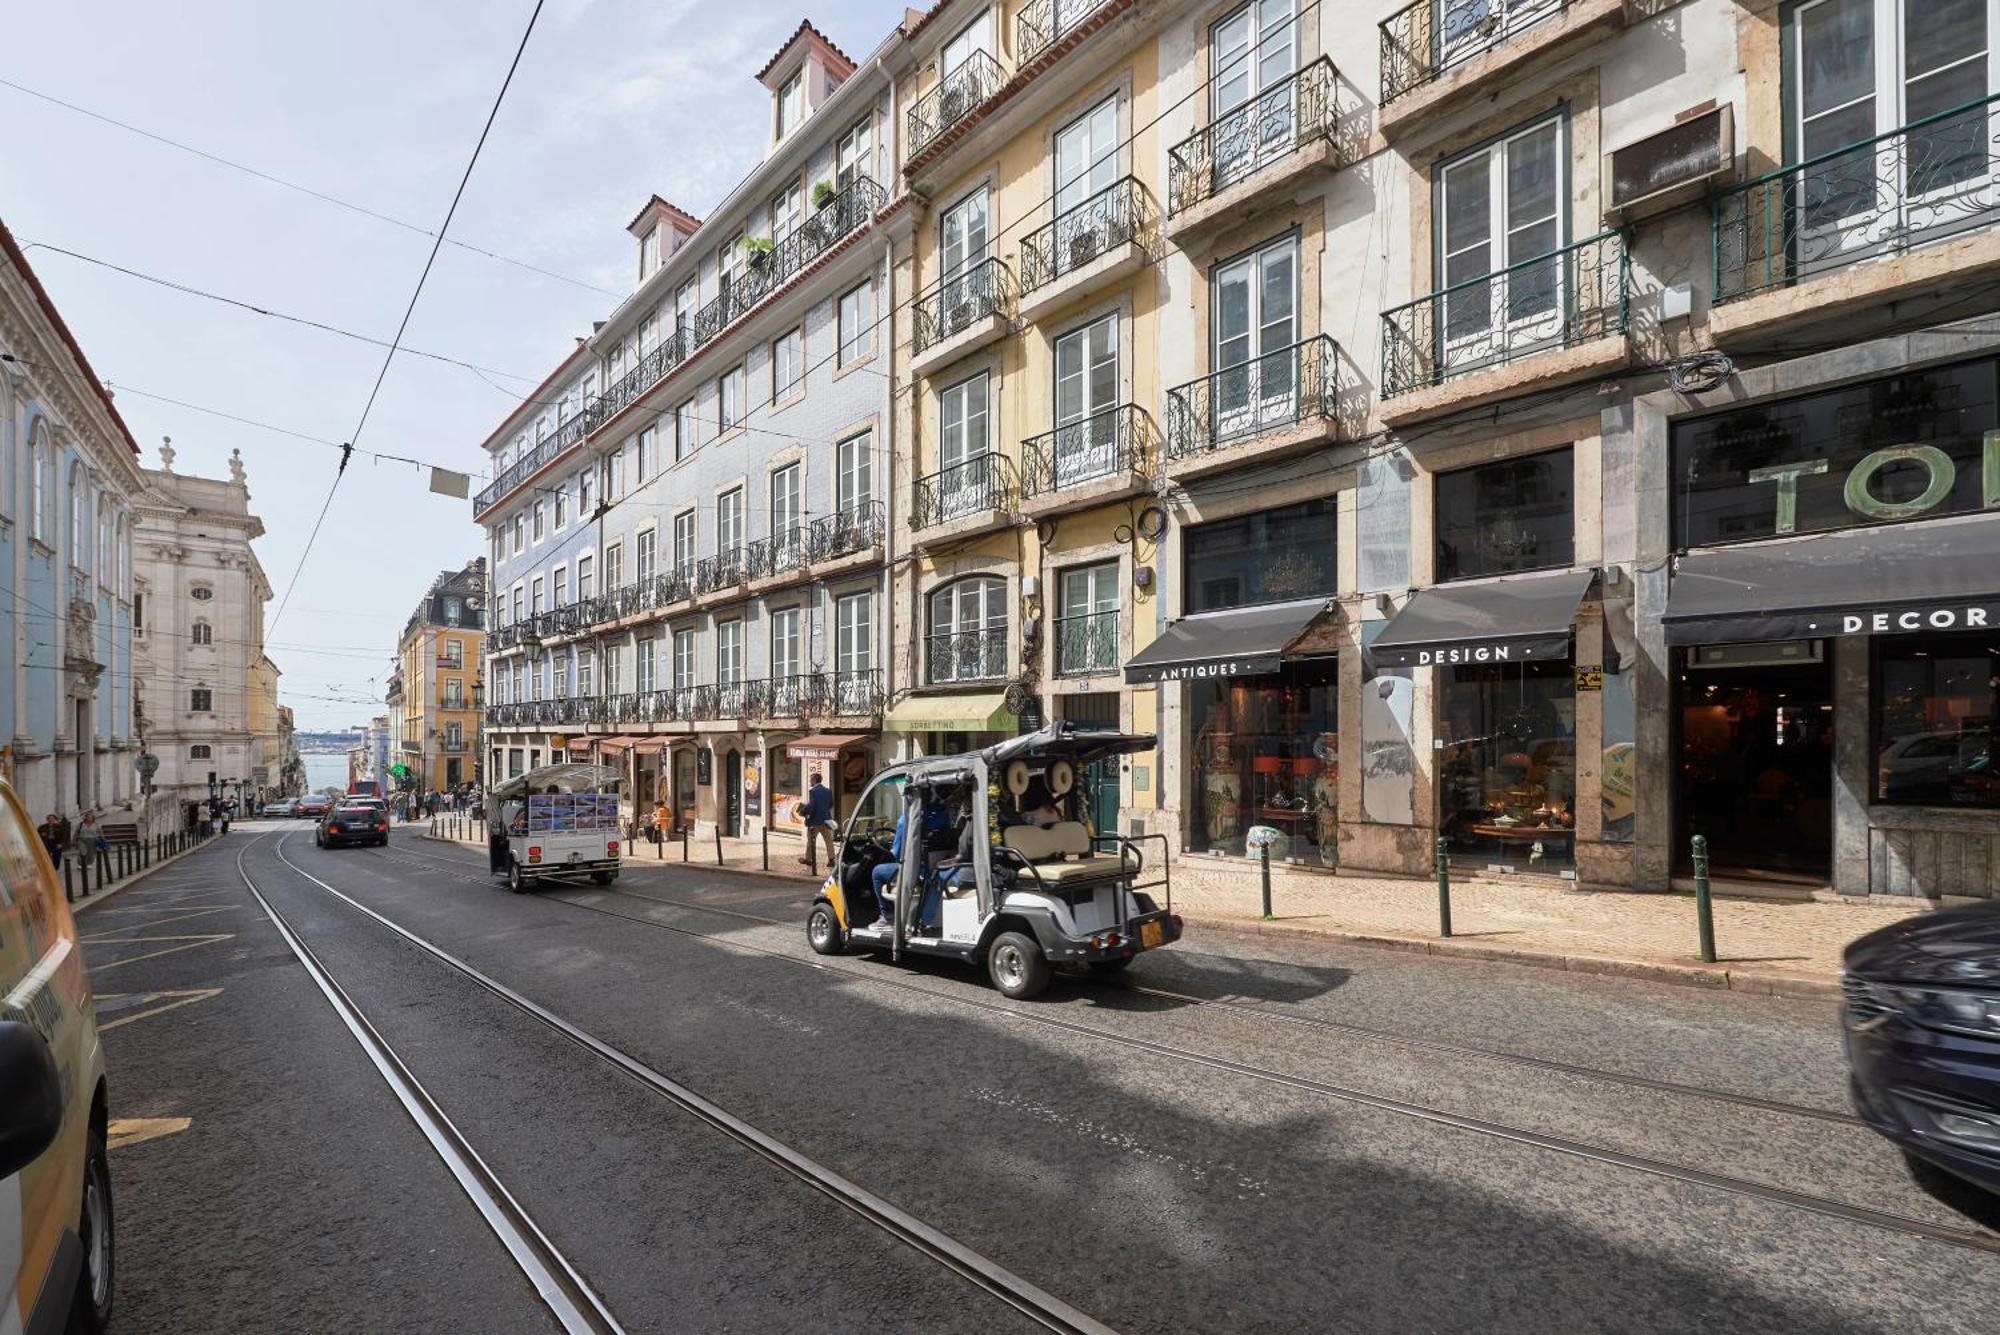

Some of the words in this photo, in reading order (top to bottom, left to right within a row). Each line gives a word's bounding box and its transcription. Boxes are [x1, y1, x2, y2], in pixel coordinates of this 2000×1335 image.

[1843, 607, 2000, 633] DECOR
[1419, 646, 1509, 665] DESIGN
[1160, 663, 1237, 680] ANTIQUES
